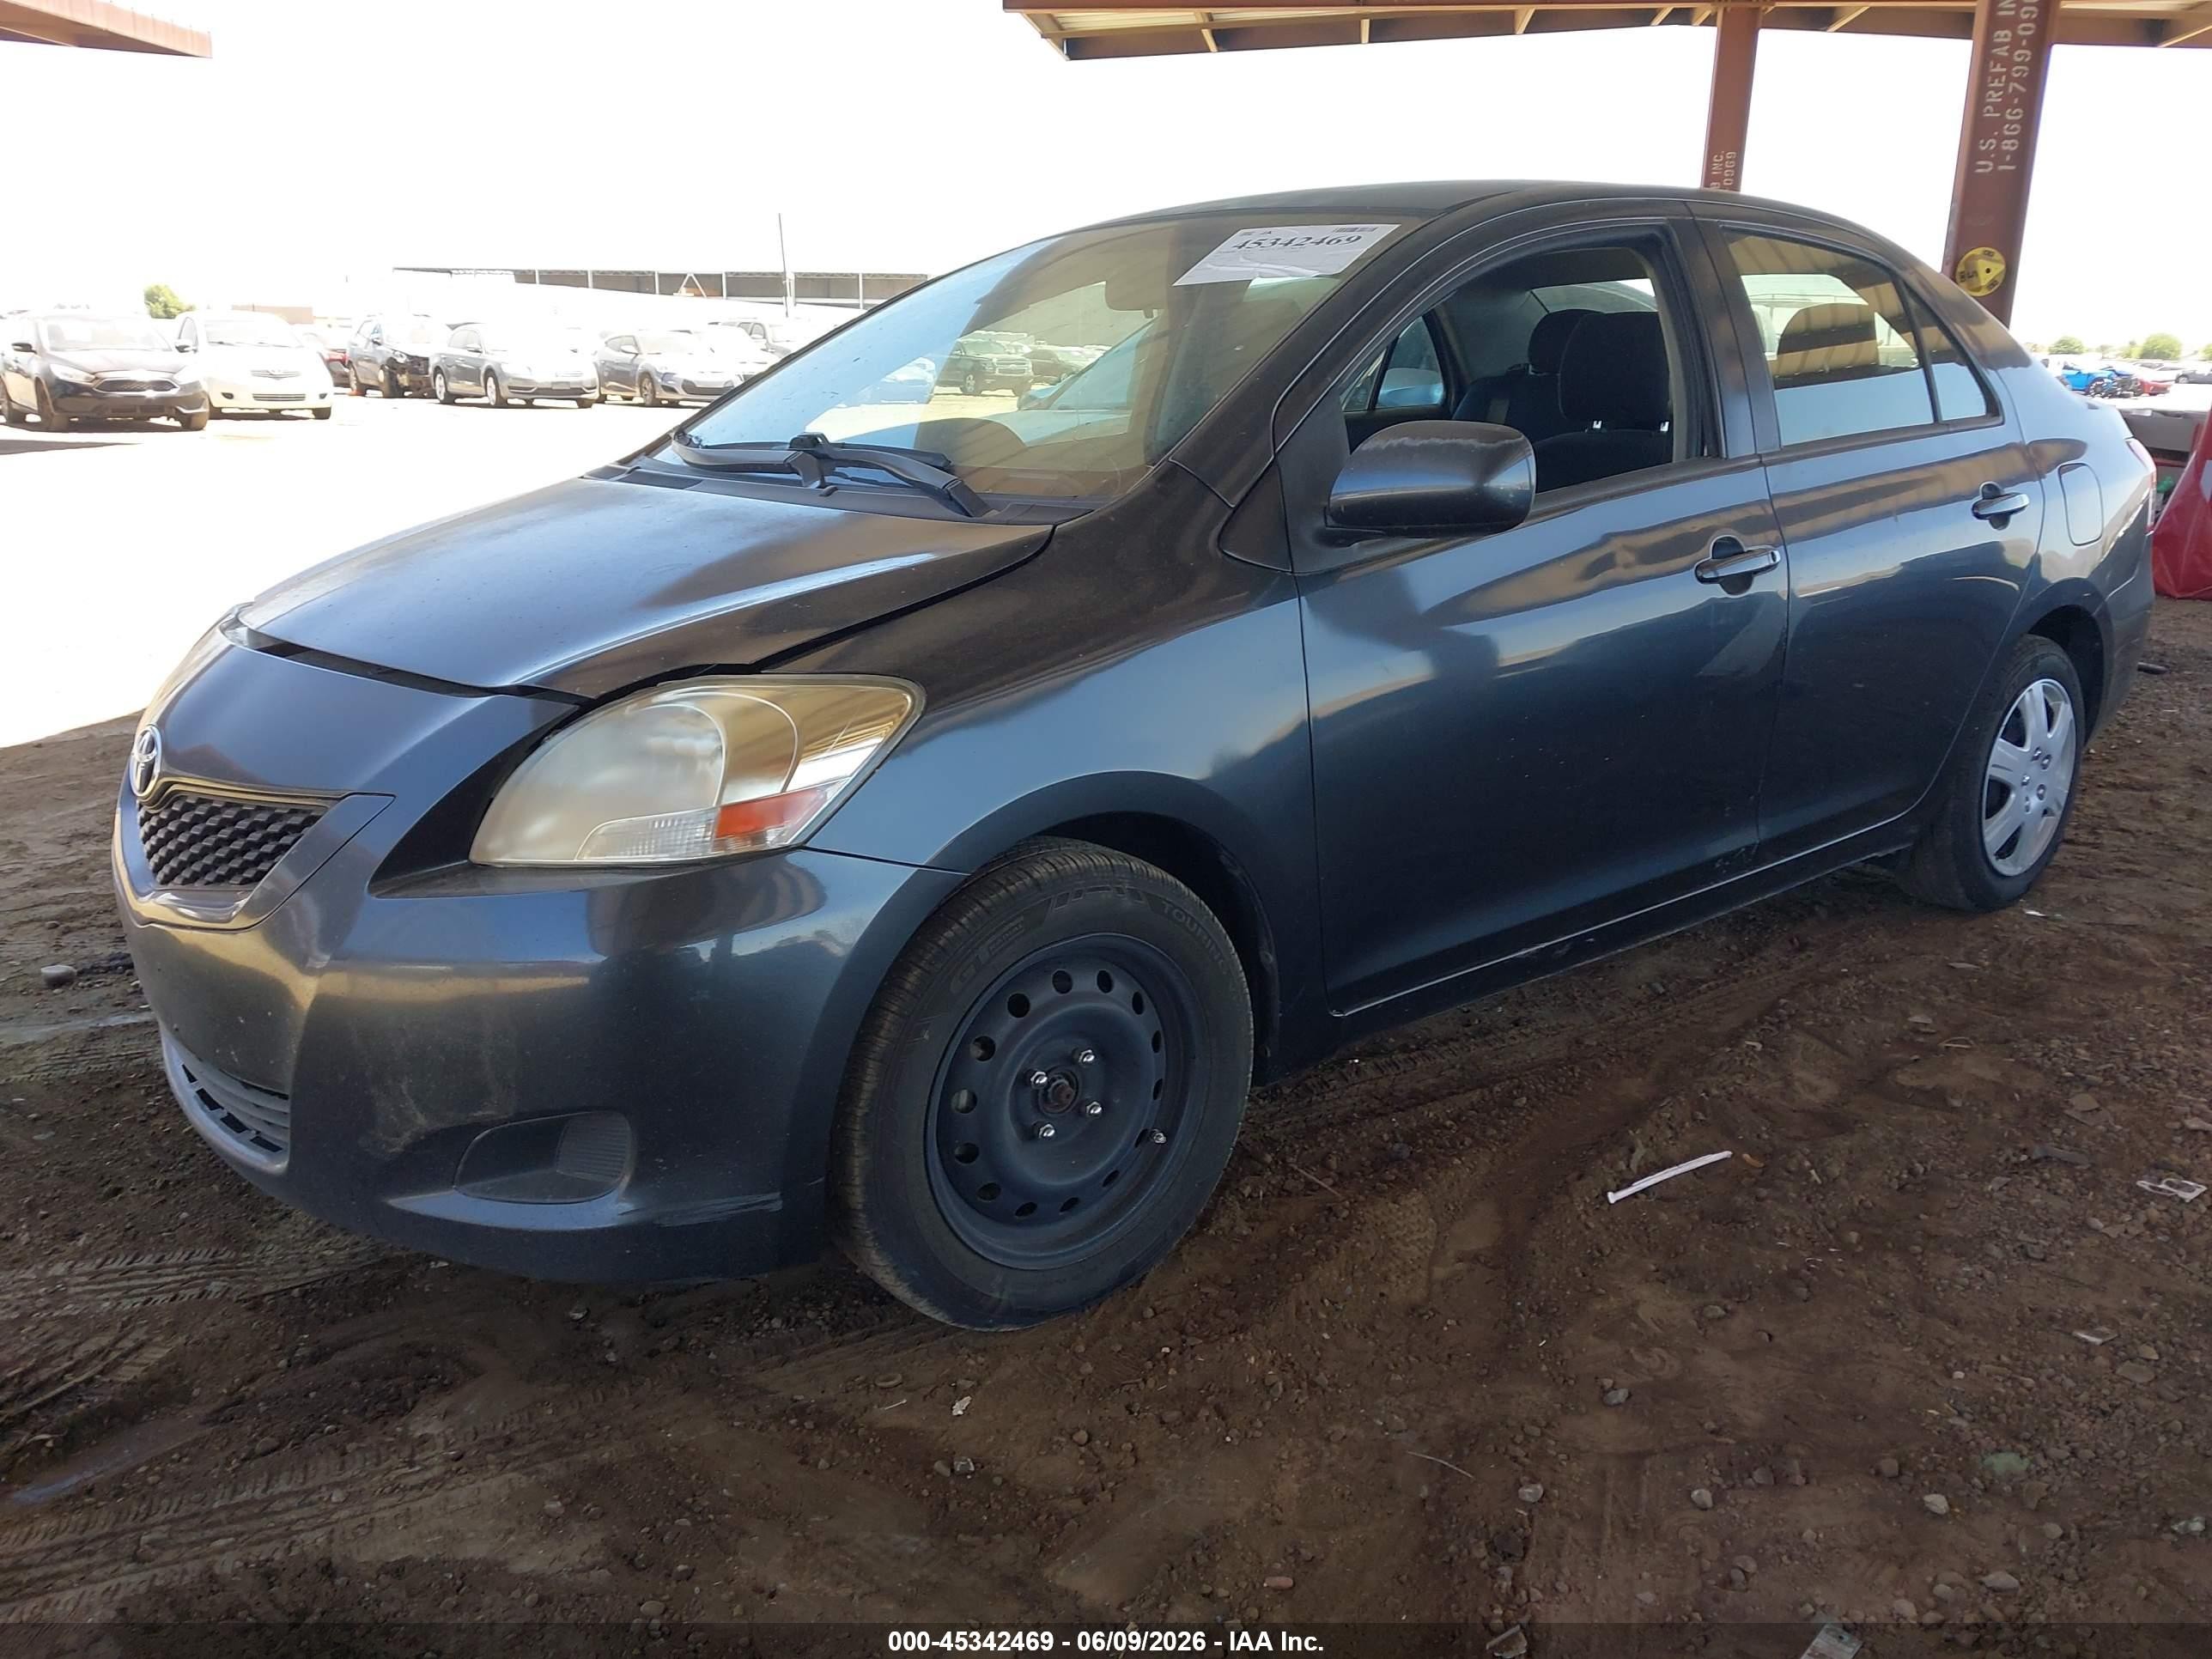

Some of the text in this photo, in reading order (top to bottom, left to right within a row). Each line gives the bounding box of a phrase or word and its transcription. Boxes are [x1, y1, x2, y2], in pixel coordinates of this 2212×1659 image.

[1982, 29, 2013, 118] PREFAB
[1997, 0, 2039, 171] 1-866-799-09
[1711, 150, 1724, 174] INC.
[1974, 131, 1999, 174] U.S.
[1231, 234, 1363, 250] 45342469
